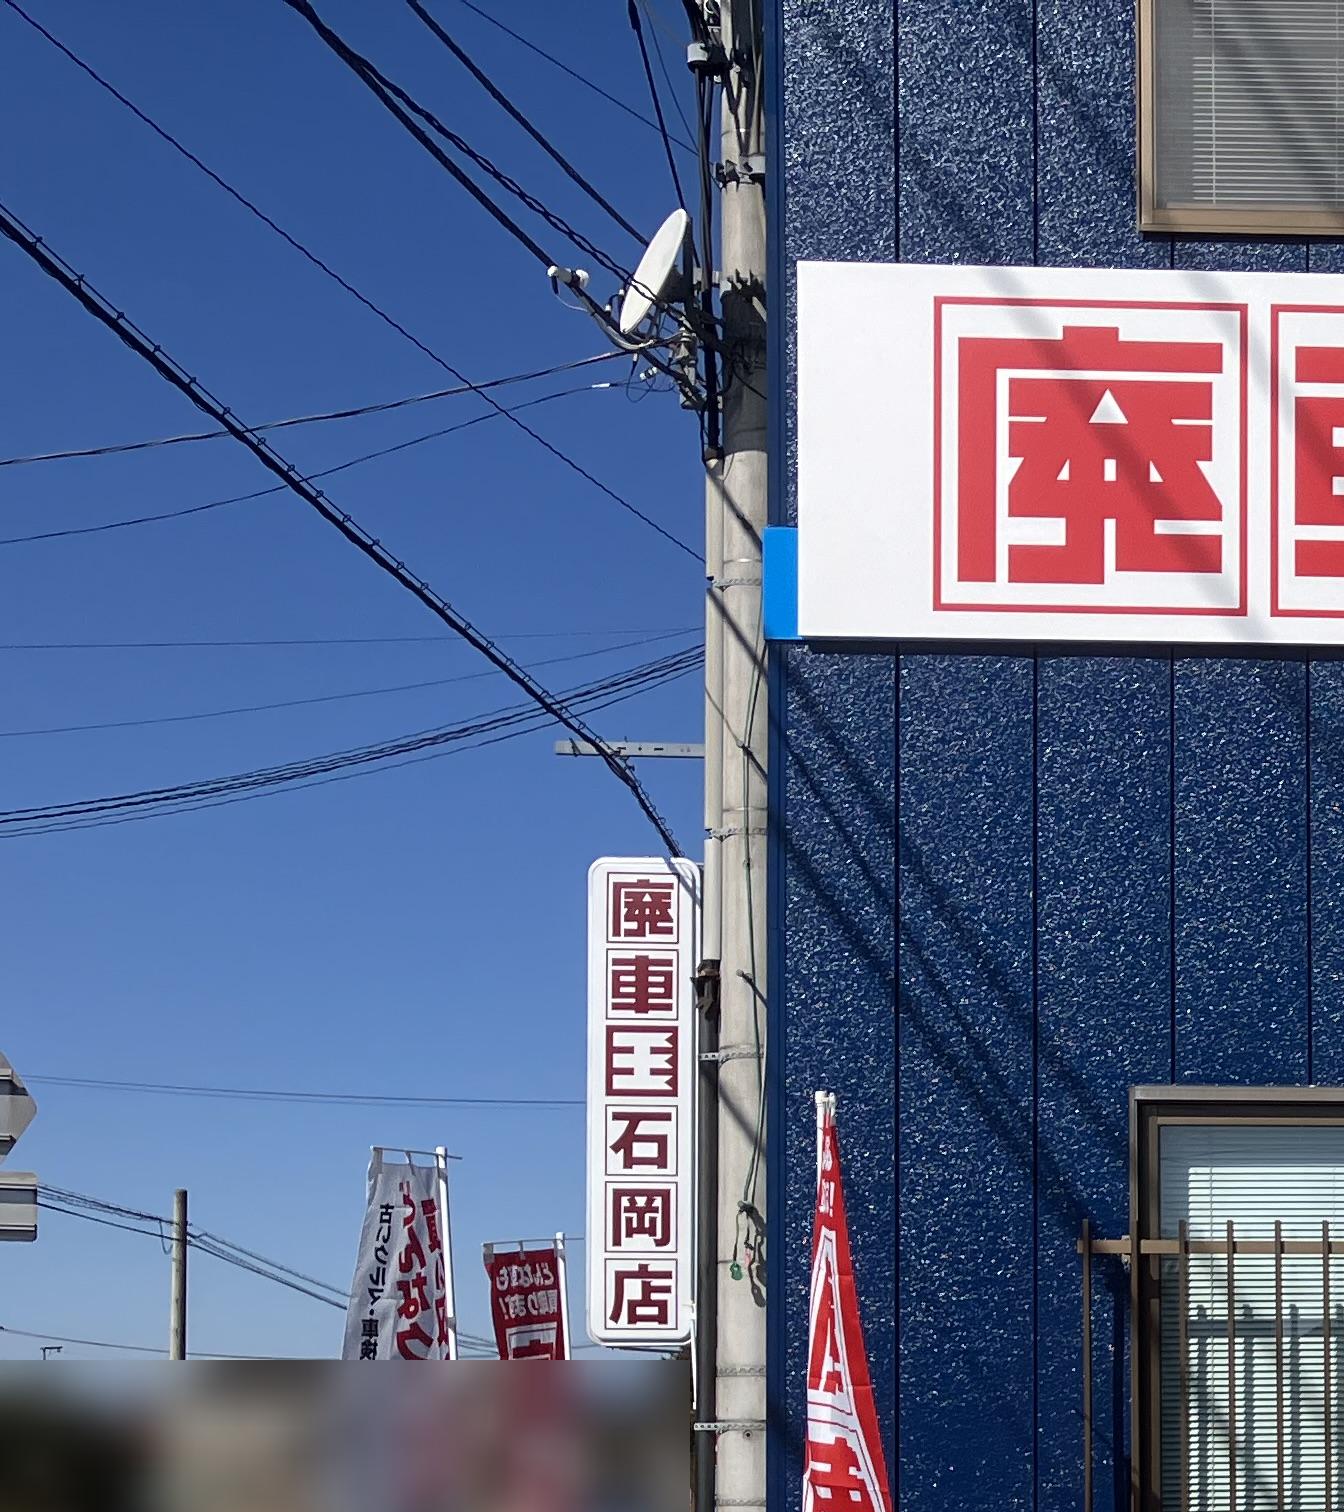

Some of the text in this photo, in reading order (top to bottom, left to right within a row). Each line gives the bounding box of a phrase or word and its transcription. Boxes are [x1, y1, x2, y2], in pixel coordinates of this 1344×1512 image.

[605, 878, 678, 1326] 廃車王石岡店
